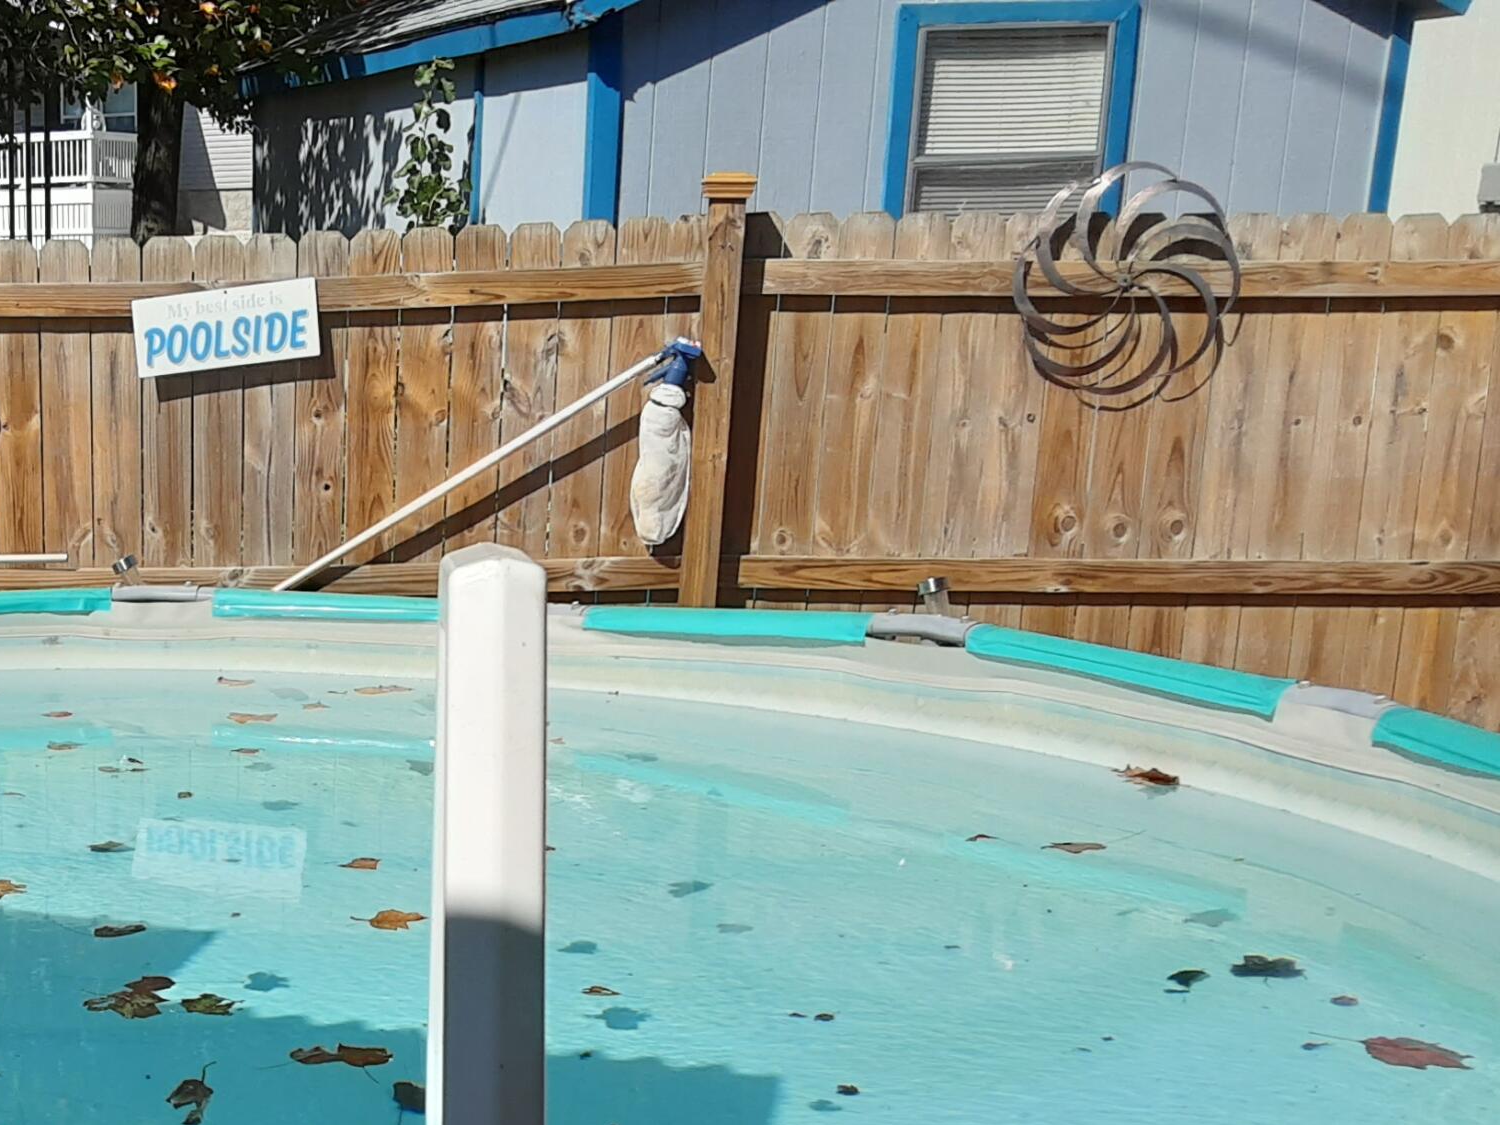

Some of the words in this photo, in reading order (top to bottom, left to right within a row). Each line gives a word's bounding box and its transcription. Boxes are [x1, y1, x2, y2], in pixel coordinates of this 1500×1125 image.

[167, 303, 191, 320] My
[195, 299, 228, 315] best
[232, 293, 265, 310] side
[268, 290, 284, 305] is
[144, 309, 307, 367] POOLSIDE
